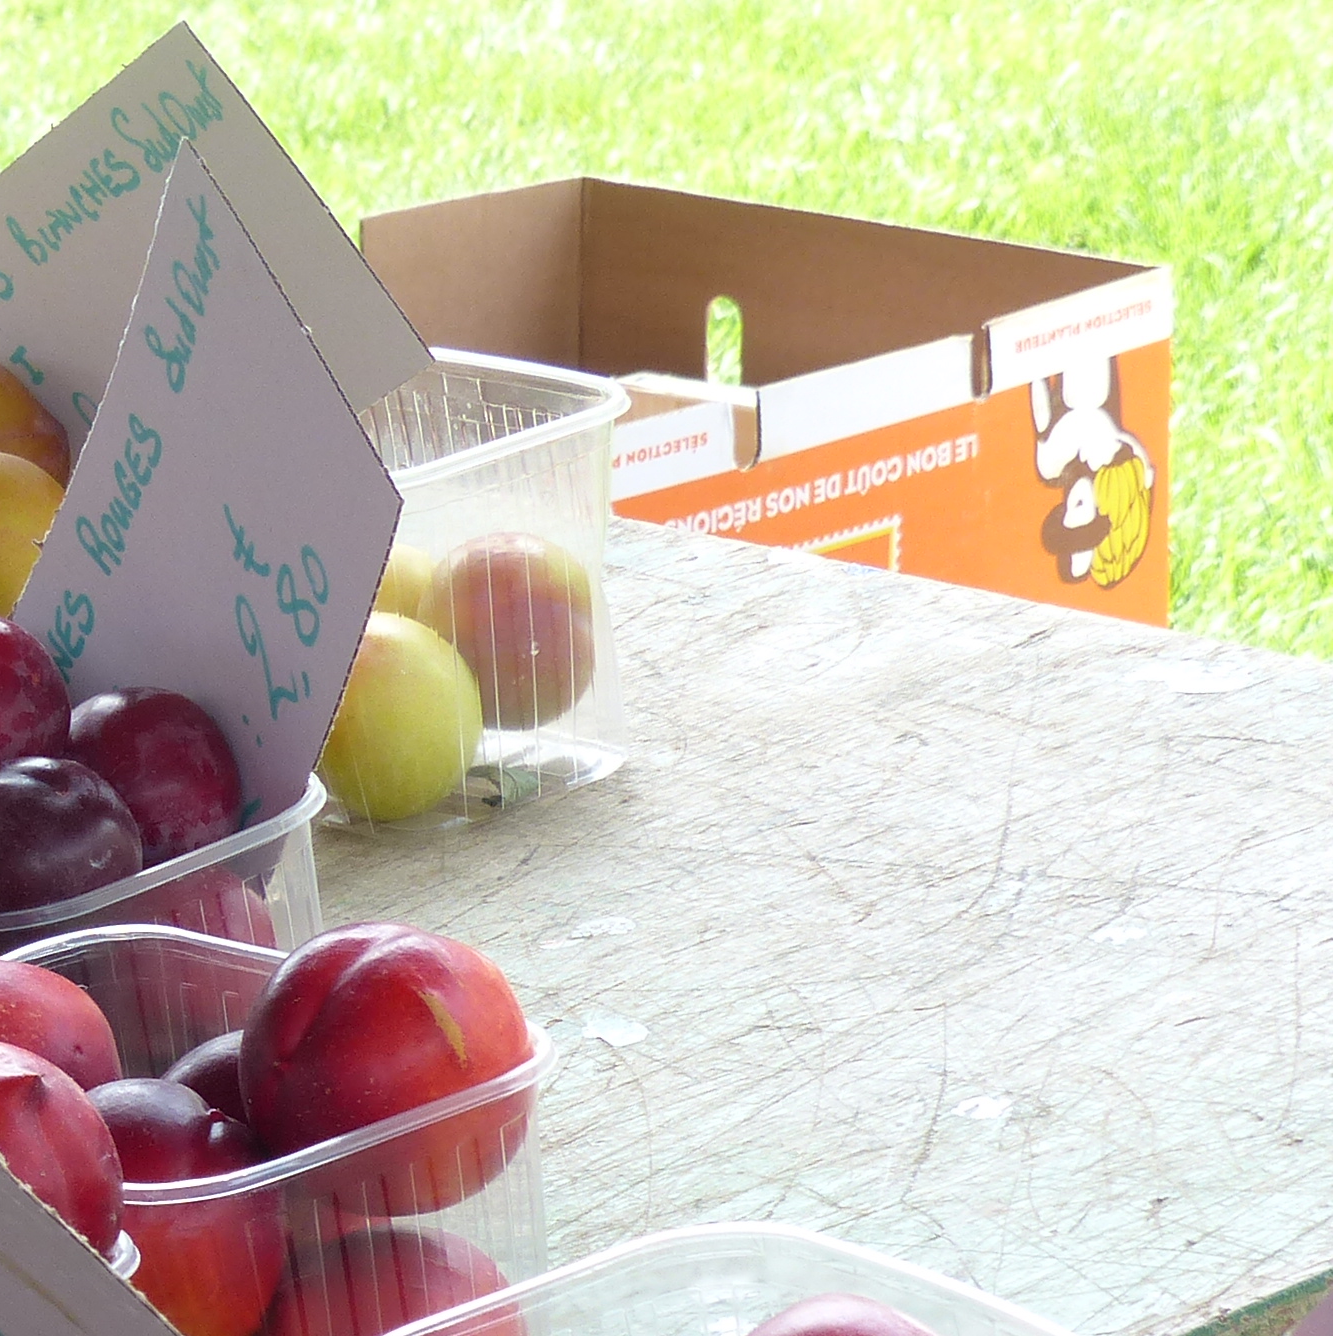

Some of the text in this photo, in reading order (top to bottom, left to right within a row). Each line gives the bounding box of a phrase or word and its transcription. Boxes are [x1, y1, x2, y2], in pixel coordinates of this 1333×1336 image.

[6, 149, 140, 267] BLANCHES
[626, 430, 709, 467] SÉLECTION
[907, 439, 953, 472] BON
[955, 433, 980, 460] LE
[75, 413, 162, 576] ROUGES
[765, 483, 811, 519] NOS
[813, 474, 844, 504] DE
